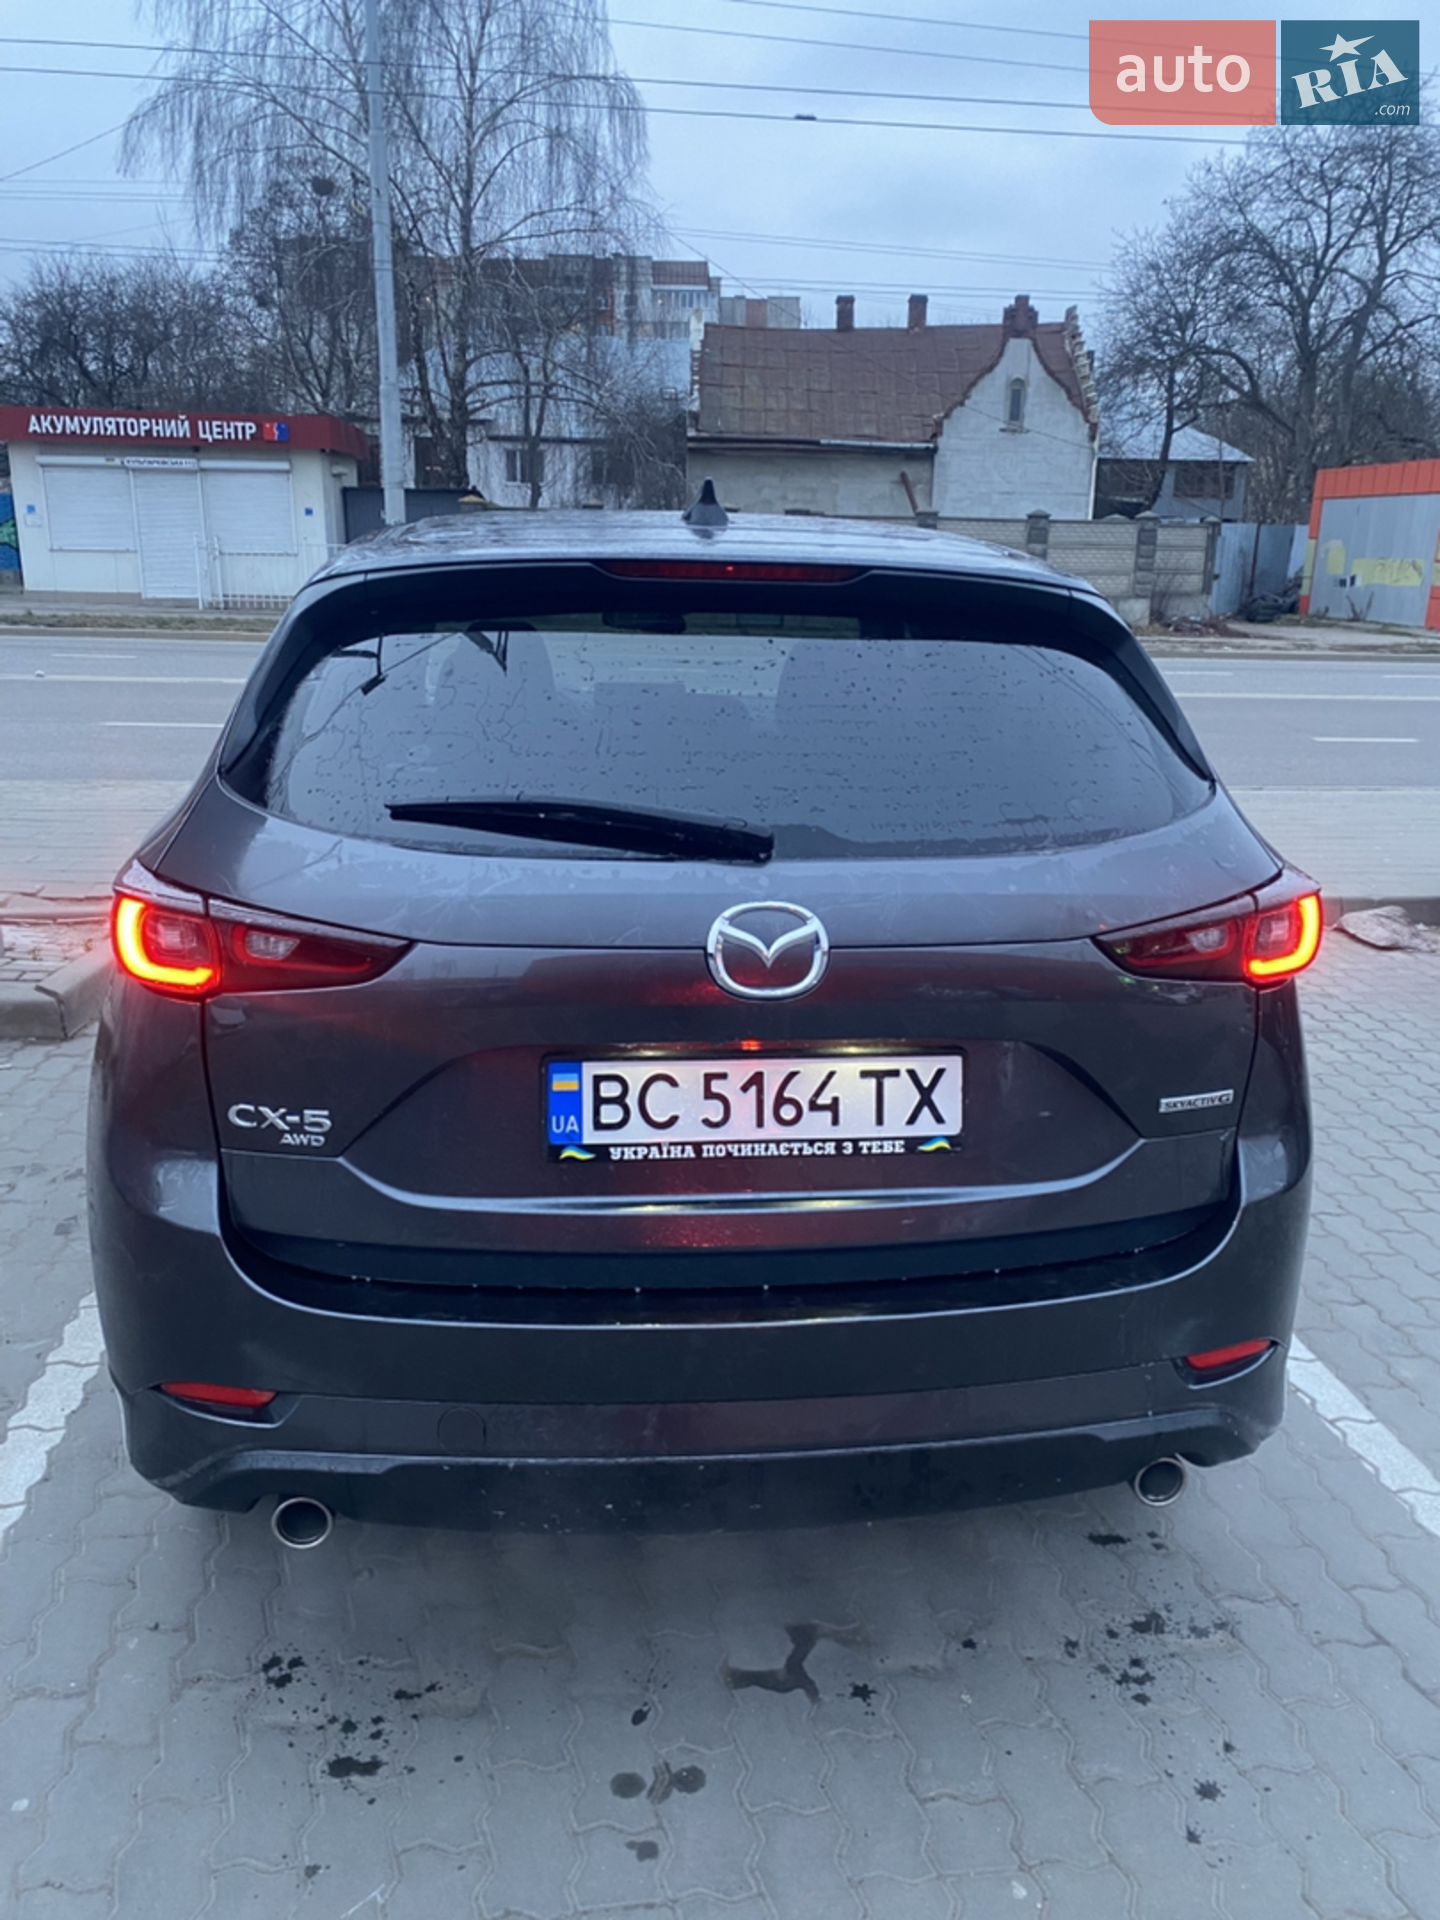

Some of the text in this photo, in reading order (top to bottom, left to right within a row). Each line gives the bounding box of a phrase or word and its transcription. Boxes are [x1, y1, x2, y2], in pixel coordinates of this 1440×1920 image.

[28, 414, 257, 443] АКУМУЛЯТОРНИЙ ЦЕНТР
[592, 1067, 947, 1132] BC 5164 TX
[227, 1103, 332, 1134] CX-5
[551, 1114, 579, 1134] UA
[279, 1133, 326, 1148] AWD
[609, 1142, 696, 1161] УКРАЇНА
[701, 1142, 837, 1159] ПОЧИНАЄТЬСЯ
[857, 1140, 906, 1155] ТЕБЕ
